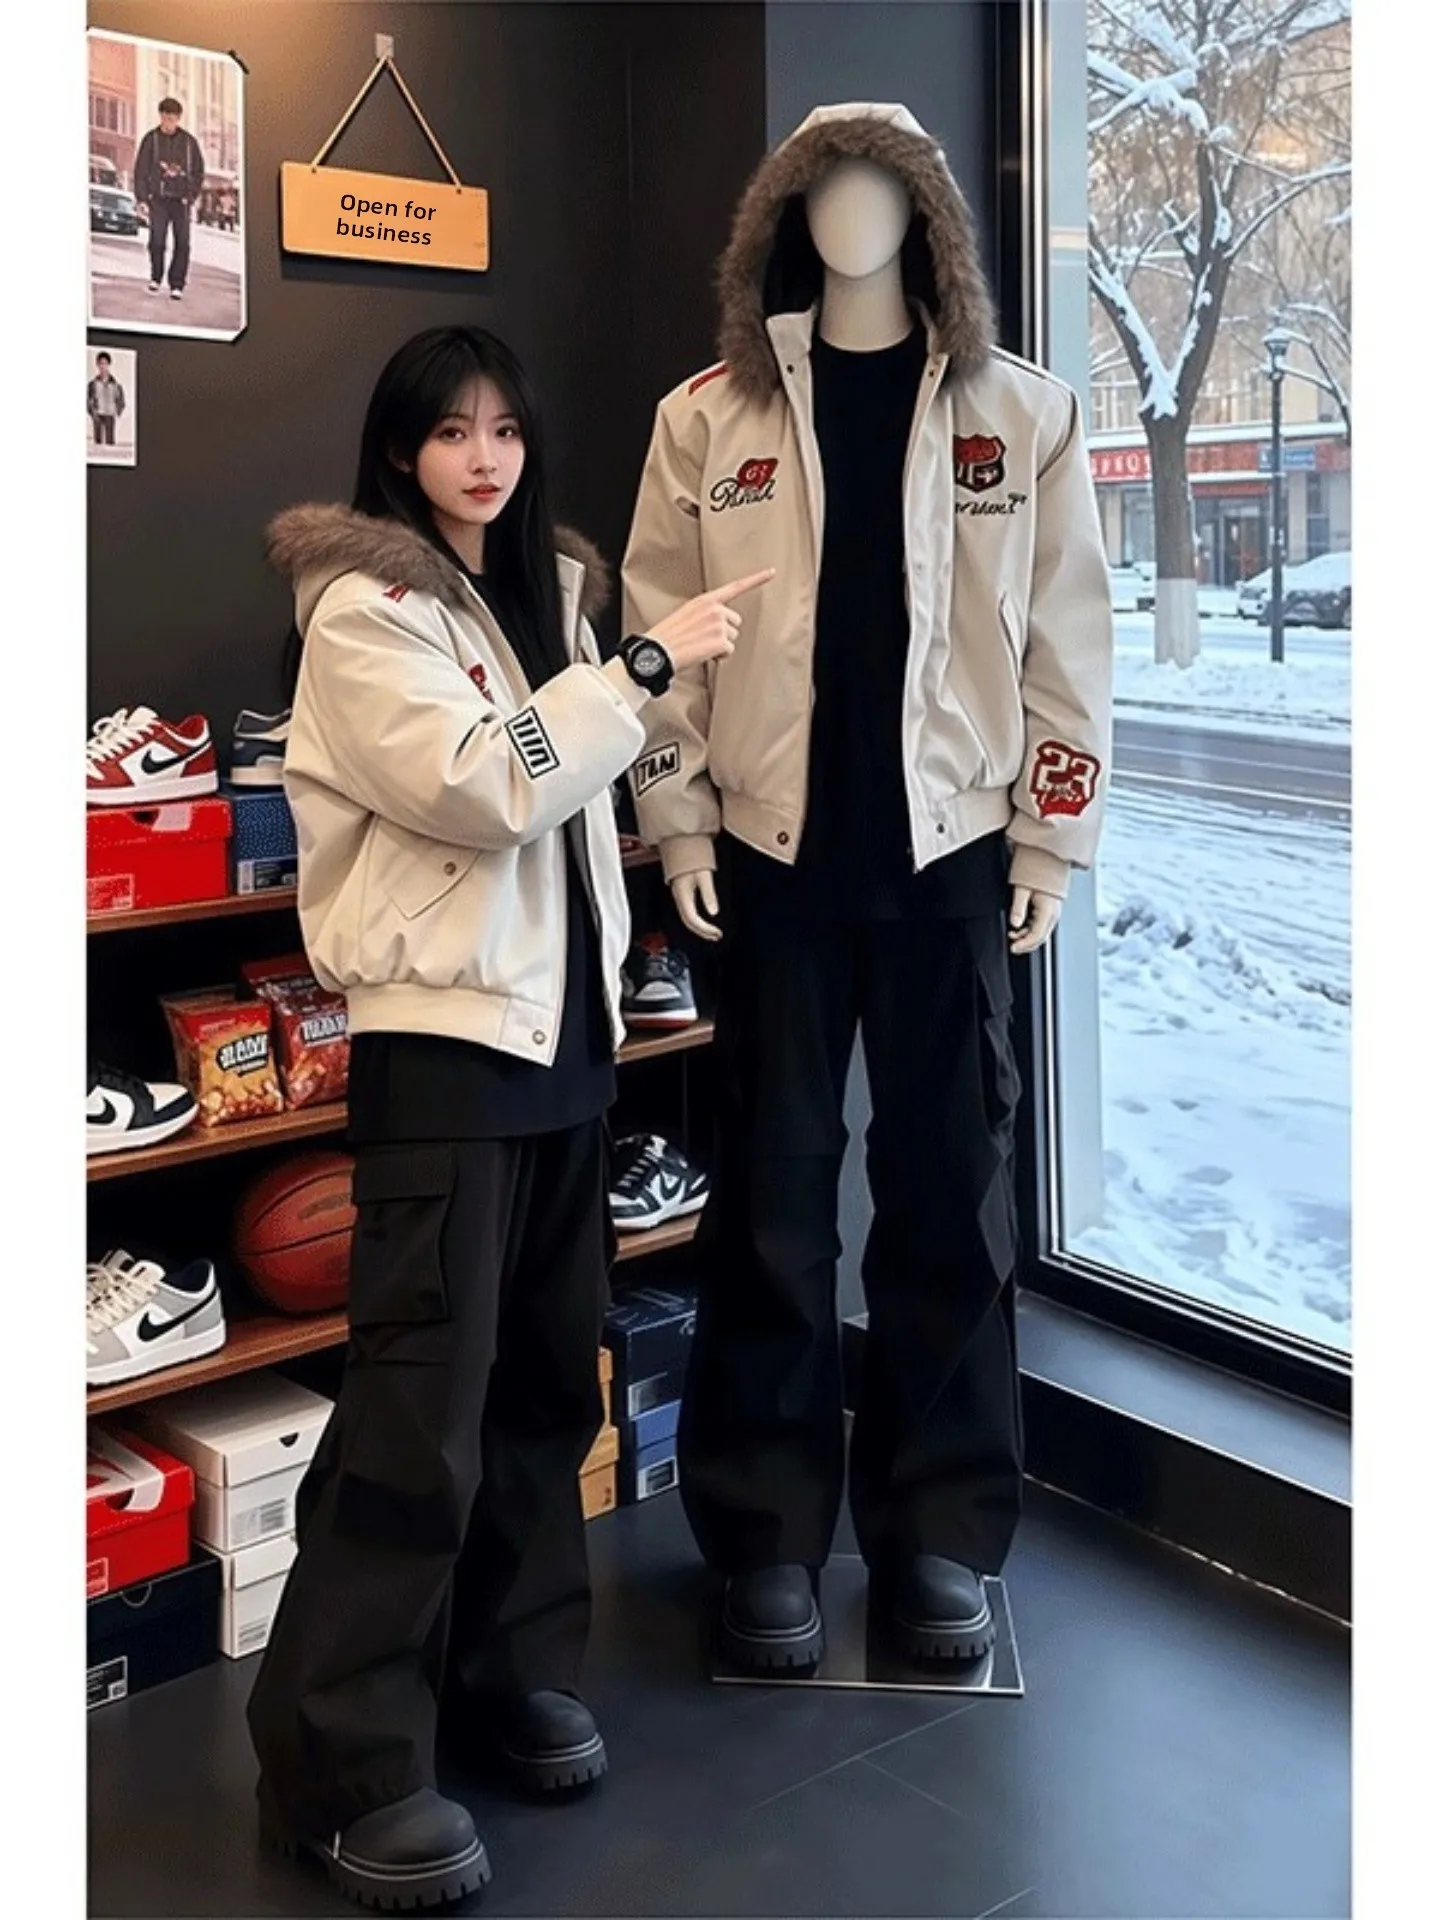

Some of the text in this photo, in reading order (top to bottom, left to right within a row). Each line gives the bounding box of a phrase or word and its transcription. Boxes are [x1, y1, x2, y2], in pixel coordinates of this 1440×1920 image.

[340, 194, 437, 221] Open for
[336, 217, 432, 246] business
